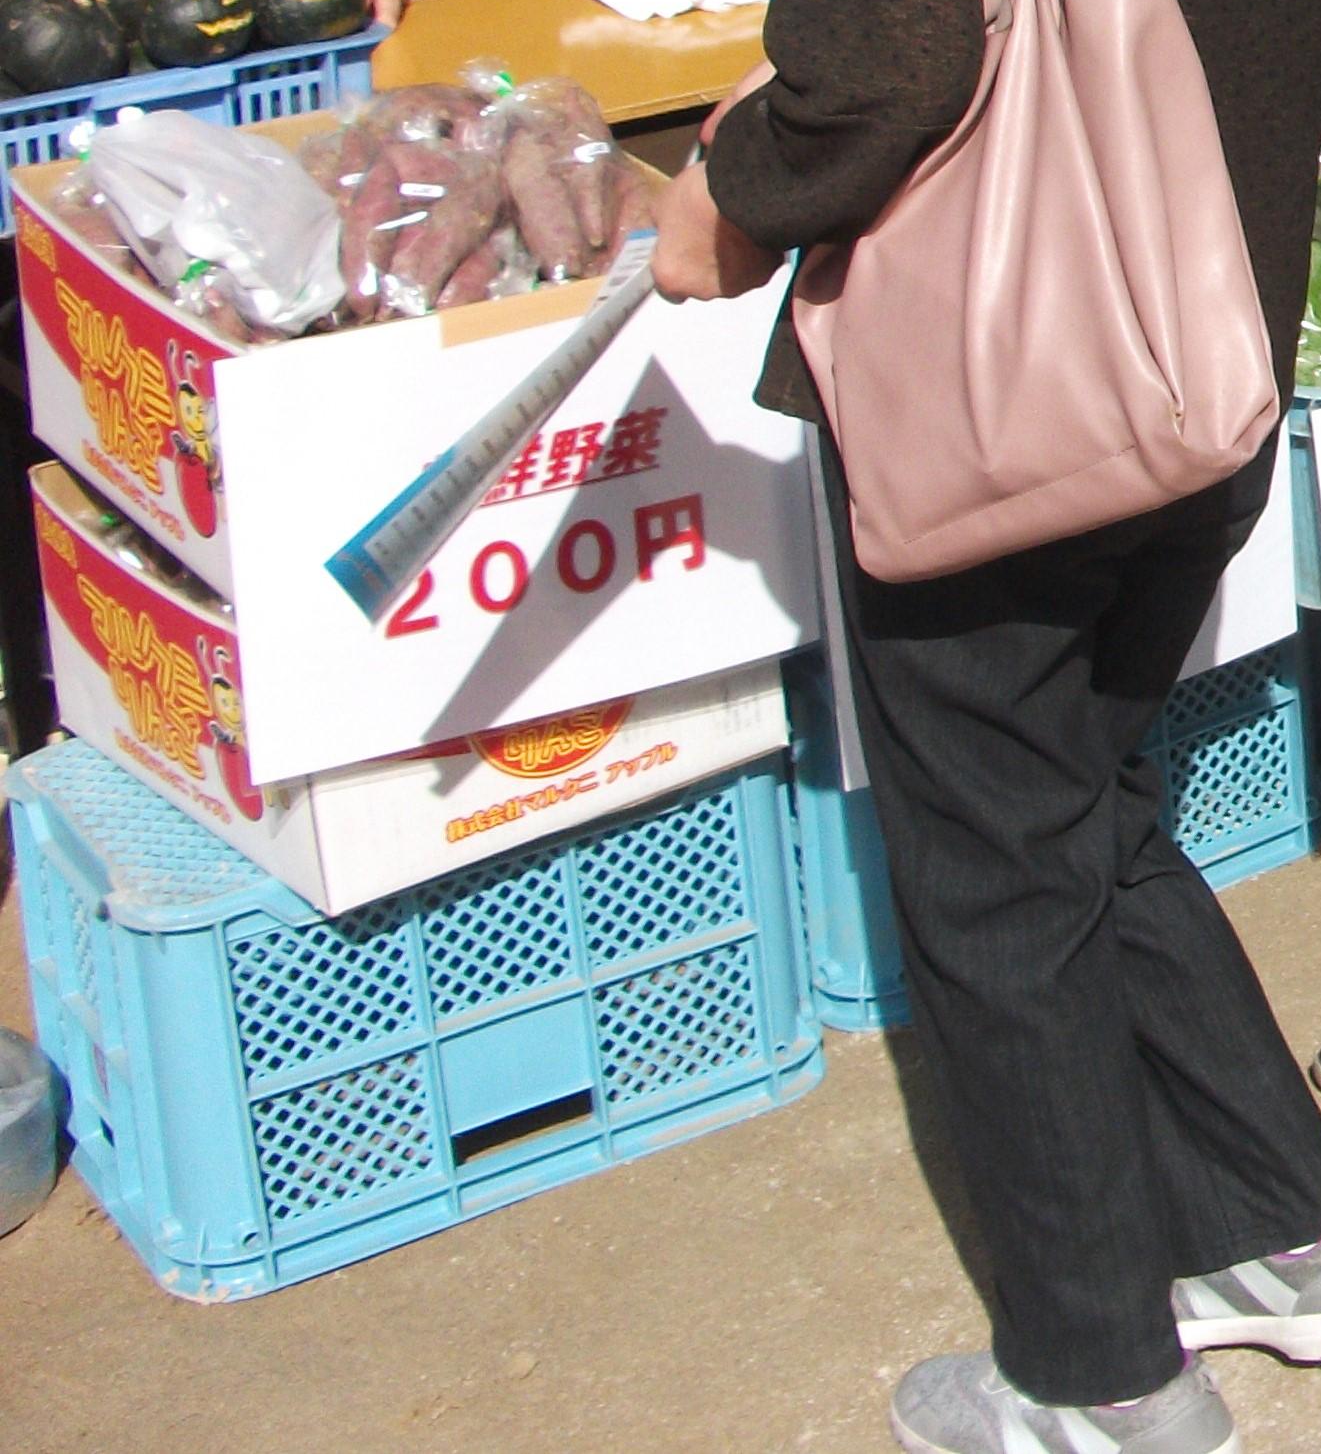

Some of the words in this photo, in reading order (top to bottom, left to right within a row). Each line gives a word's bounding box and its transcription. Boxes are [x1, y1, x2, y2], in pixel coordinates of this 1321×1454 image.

[483, 406, 669, 503] 鮮野菜
[383, 492, 708, 640] 200円
